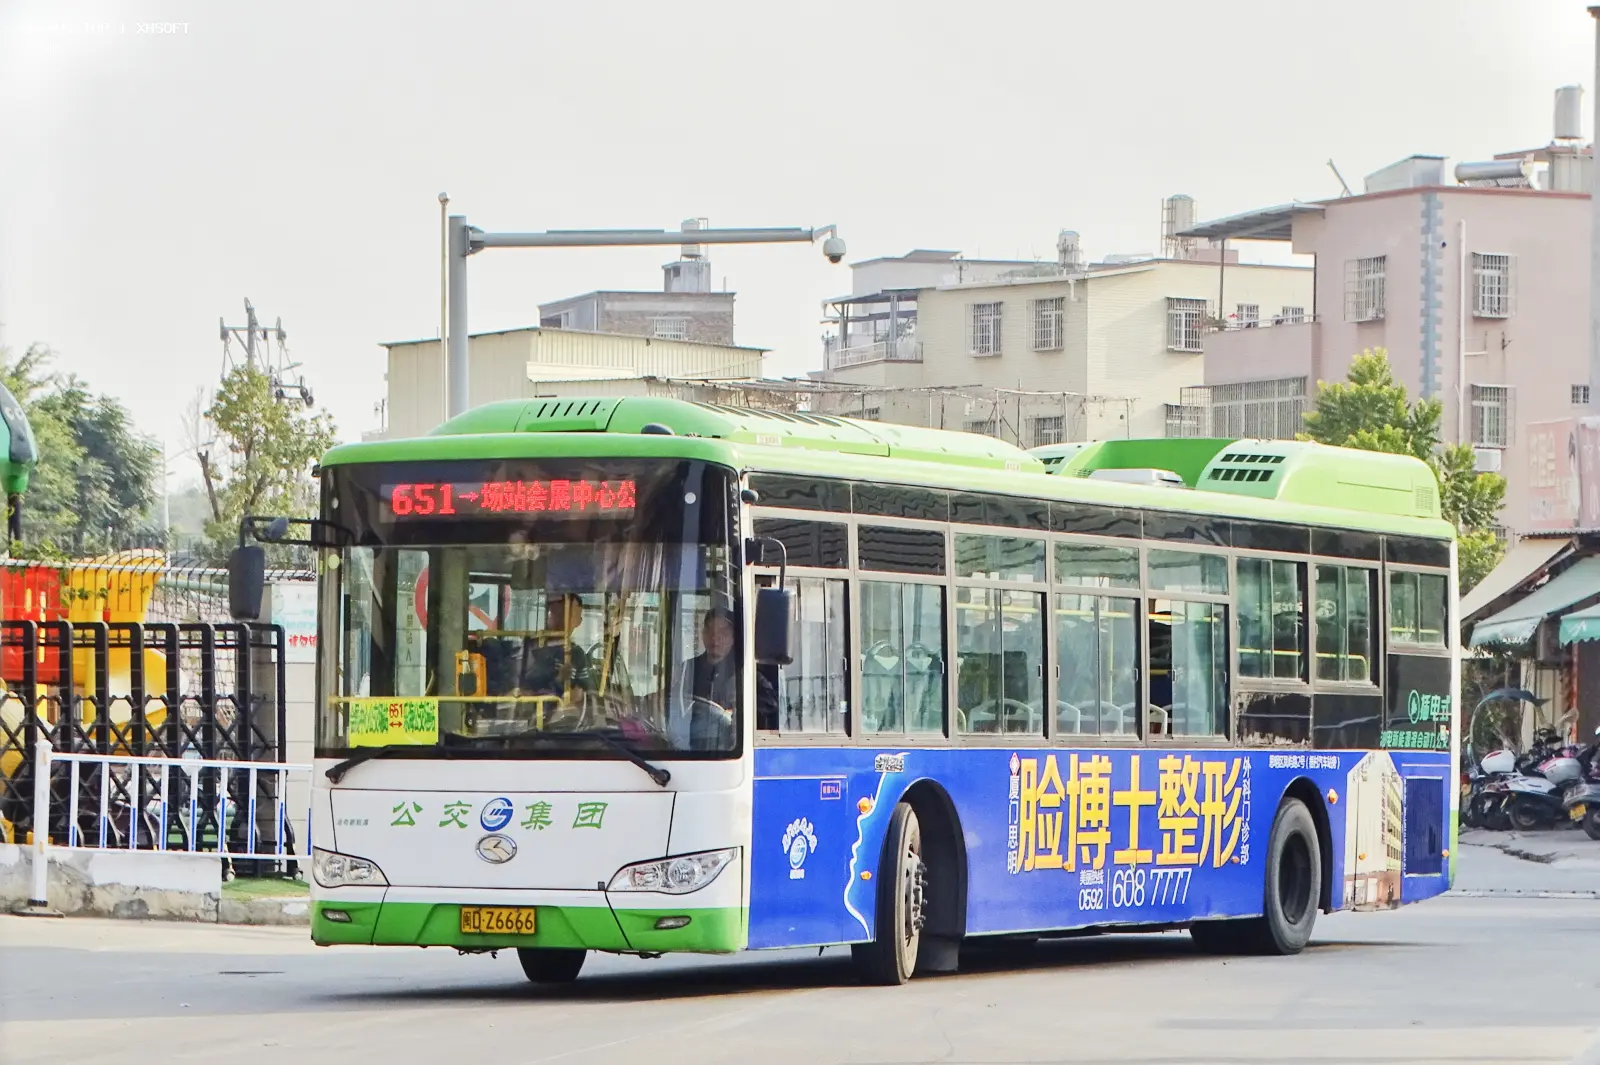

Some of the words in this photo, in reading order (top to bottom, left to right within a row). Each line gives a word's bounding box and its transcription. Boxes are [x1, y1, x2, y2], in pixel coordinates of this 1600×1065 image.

[392, 484, 456, 515] 651
[480, 480, 636, 511] 场站会展中心公
[389, 703, 403, 718] 651
[1017, 753, 1242, 873] 脸博士整形
[1240, 756, 1251, 865] 外科门诊部
[1079, 888, 1103, 910] 0592
[1112, 869, 1146, 906] 608
[1150, 868, 1192, 905] 7777
